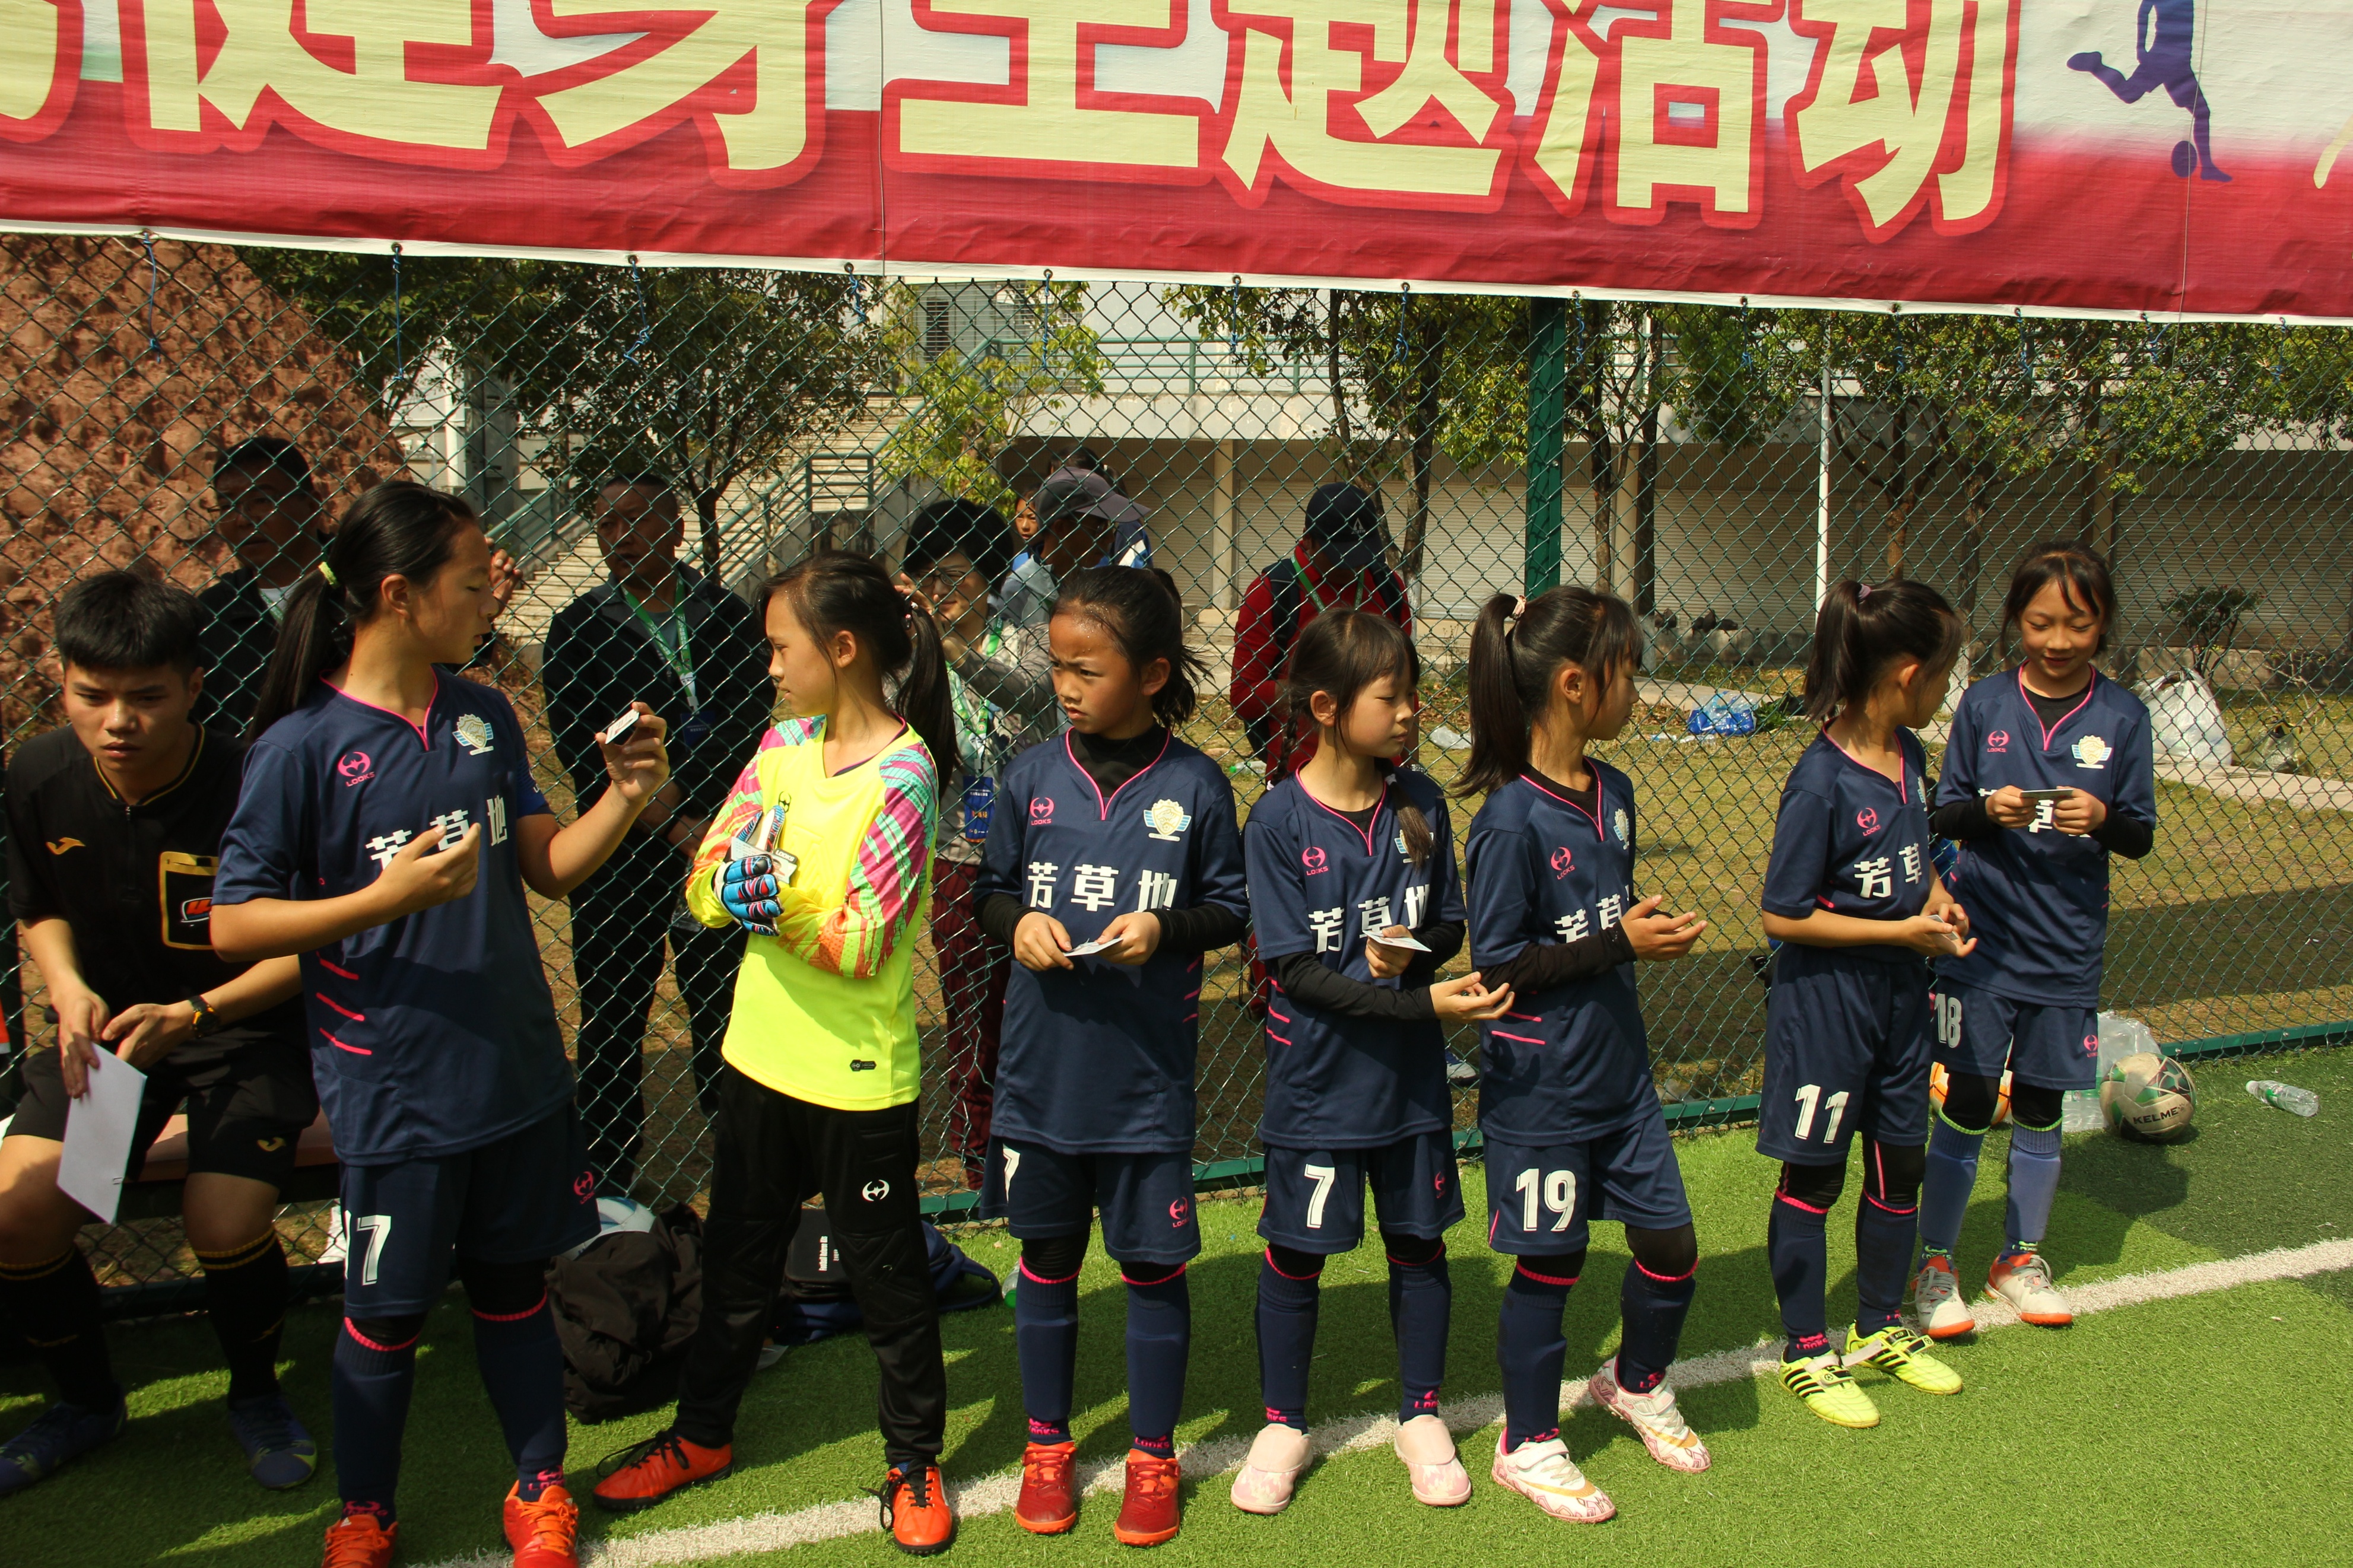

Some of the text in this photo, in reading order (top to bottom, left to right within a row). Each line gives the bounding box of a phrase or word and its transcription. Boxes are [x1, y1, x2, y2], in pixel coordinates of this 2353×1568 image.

[345, 771, 375, 787] LOOKS
[1031, 818, 1052, 826] LOOKS
[1862, 825, 1881, 837] LOOKS
[775, 849, 796, 862] LOOKS
[1306, 866, 1329, 876] LOOKS
[1557, 865, 1575, 880] LOOKS
[1854, 837, 1930, 899] 芳草
[1027, 861, 1177, 912] 芳草地
[1554, 886, 1630, 943] 芳草
[1933, 993, 1962, 1049] 18
[1795, 1083, 1849, 1144] 11
[2133, 1106, 2179, 1125] KELME
[1304, 1163, 1335, 1229] 7
[1516, 1168, 1576, 1232] 19
[1028, 1425, 1059, 1435] OOKS
[1135, 1436, 1170, 1449] LOOKS
